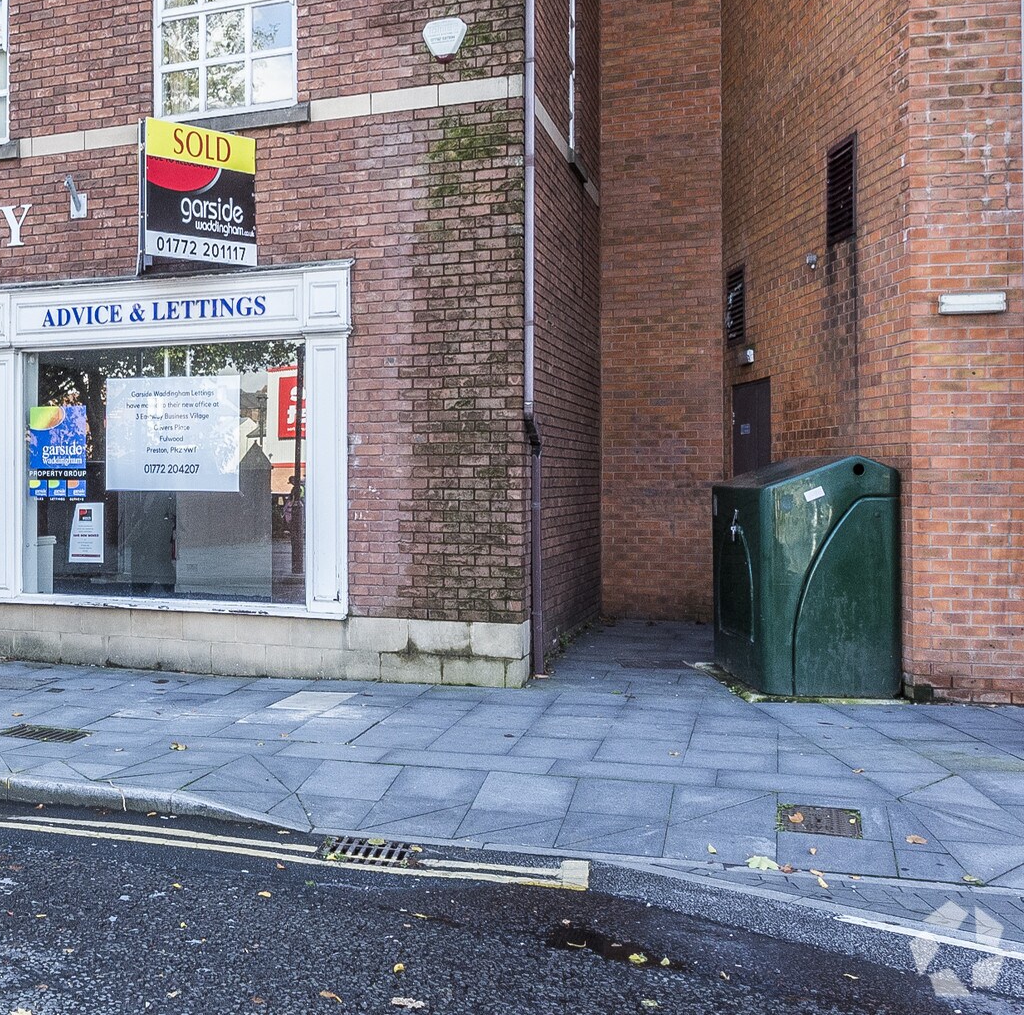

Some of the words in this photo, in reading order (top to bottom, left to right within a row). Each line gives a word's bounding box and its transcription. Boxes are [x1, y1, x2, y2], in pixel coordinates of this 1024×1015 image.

[173, 127, 231, 163] SOLD
[180, 197, 244, 224] garside
[156, 236, 197, 255] 01772
[202, 242, 246, 261] 201117
[42, 304, 123, 327] ADVICE
[129, 302, 145, 322] &
[151, 295, 267, 321] LETTINGS
[191, 389, 214, 397] Lettings
[42, 439, 83, 459] garside
[146, 446, 169, 454] Preston,
[144, 464, 166, 474] 01772
[167, 464, 200, 474] 204207
